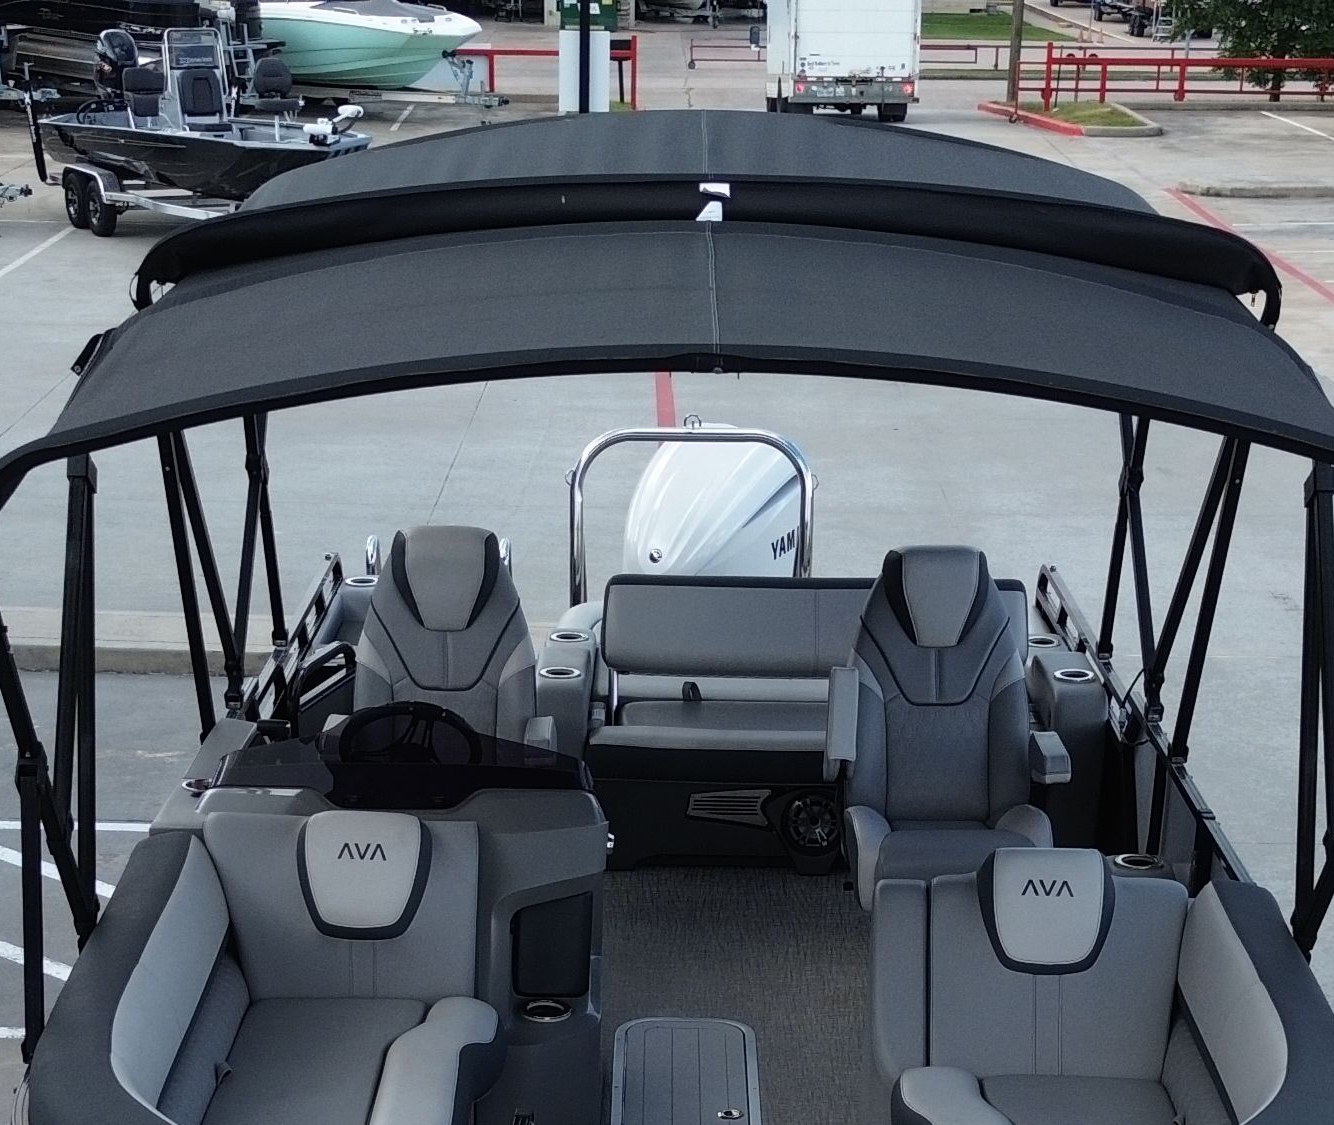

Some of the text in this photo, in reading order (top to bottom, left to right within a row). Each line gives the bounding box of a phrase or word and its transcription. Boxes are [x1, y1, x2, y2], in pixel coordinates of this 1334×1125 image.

[771, 528, 796, 560] YAM
[337, 842, 387, 861] AVA
[1021, 879, 1074, 898] AVA
